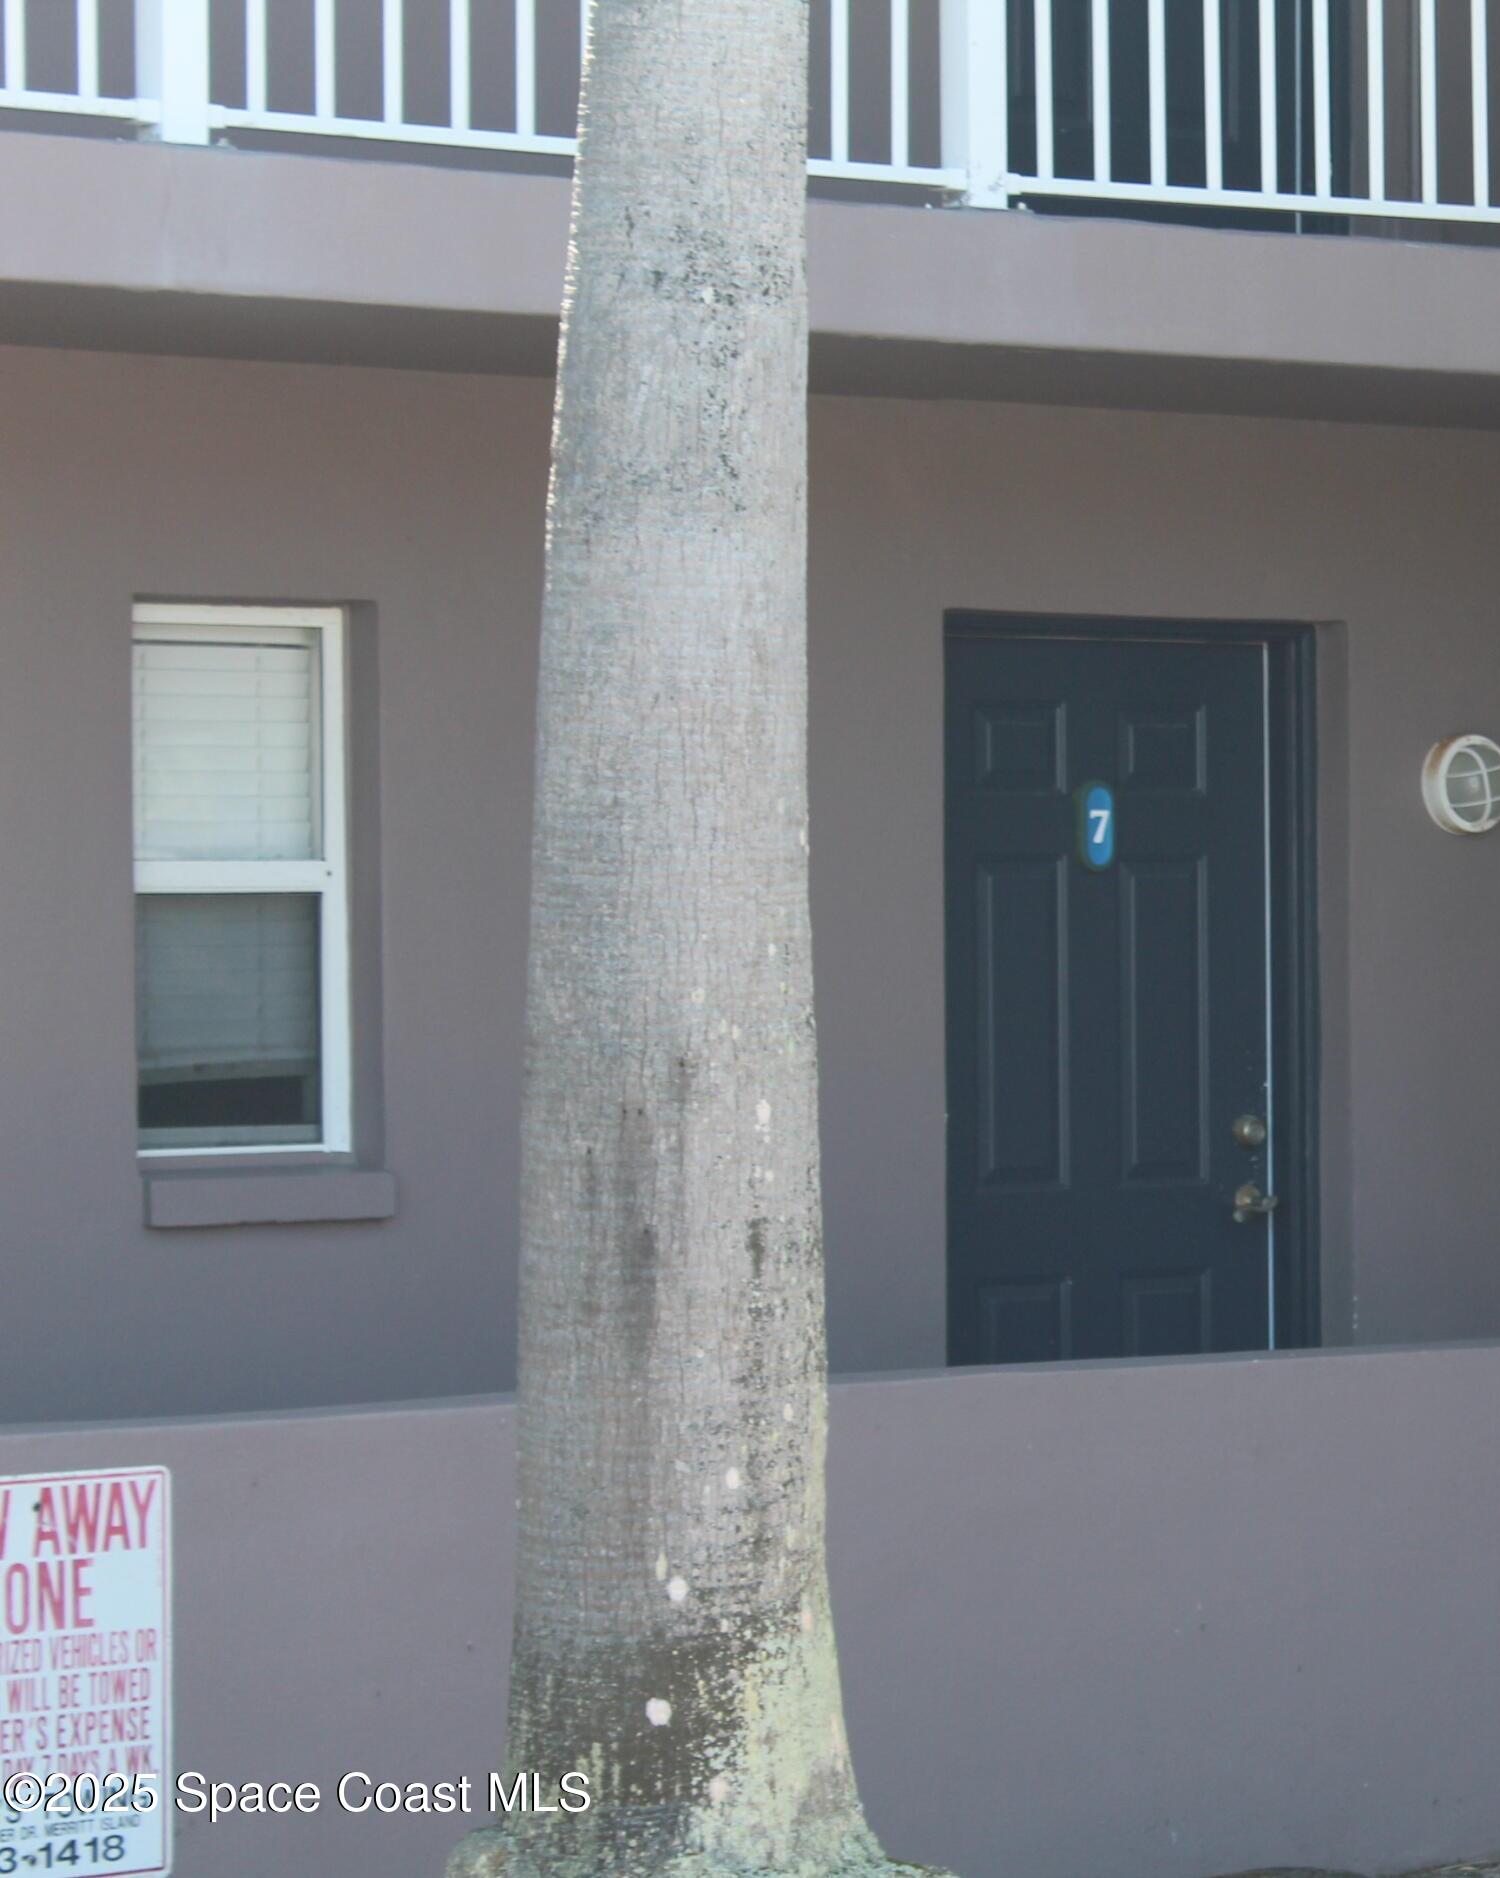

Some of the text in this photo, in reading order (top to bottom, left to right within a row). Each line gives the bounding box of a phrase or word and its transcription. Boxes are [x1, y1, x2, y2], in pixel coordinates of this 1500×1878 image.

[1089, 809, 1111, 844] 7
[33, 1479, 156, 1557] AWAY
[5, 1558, 95, 1635] ONE
[50, 1631, 129, 1670] VEHICLES
[136, 1628, 157, 1661] OR
[7, 1667, 149, 1713] WILL BE TOWED
[0, 1706, 150, 1753] ER'S EXPENSE
